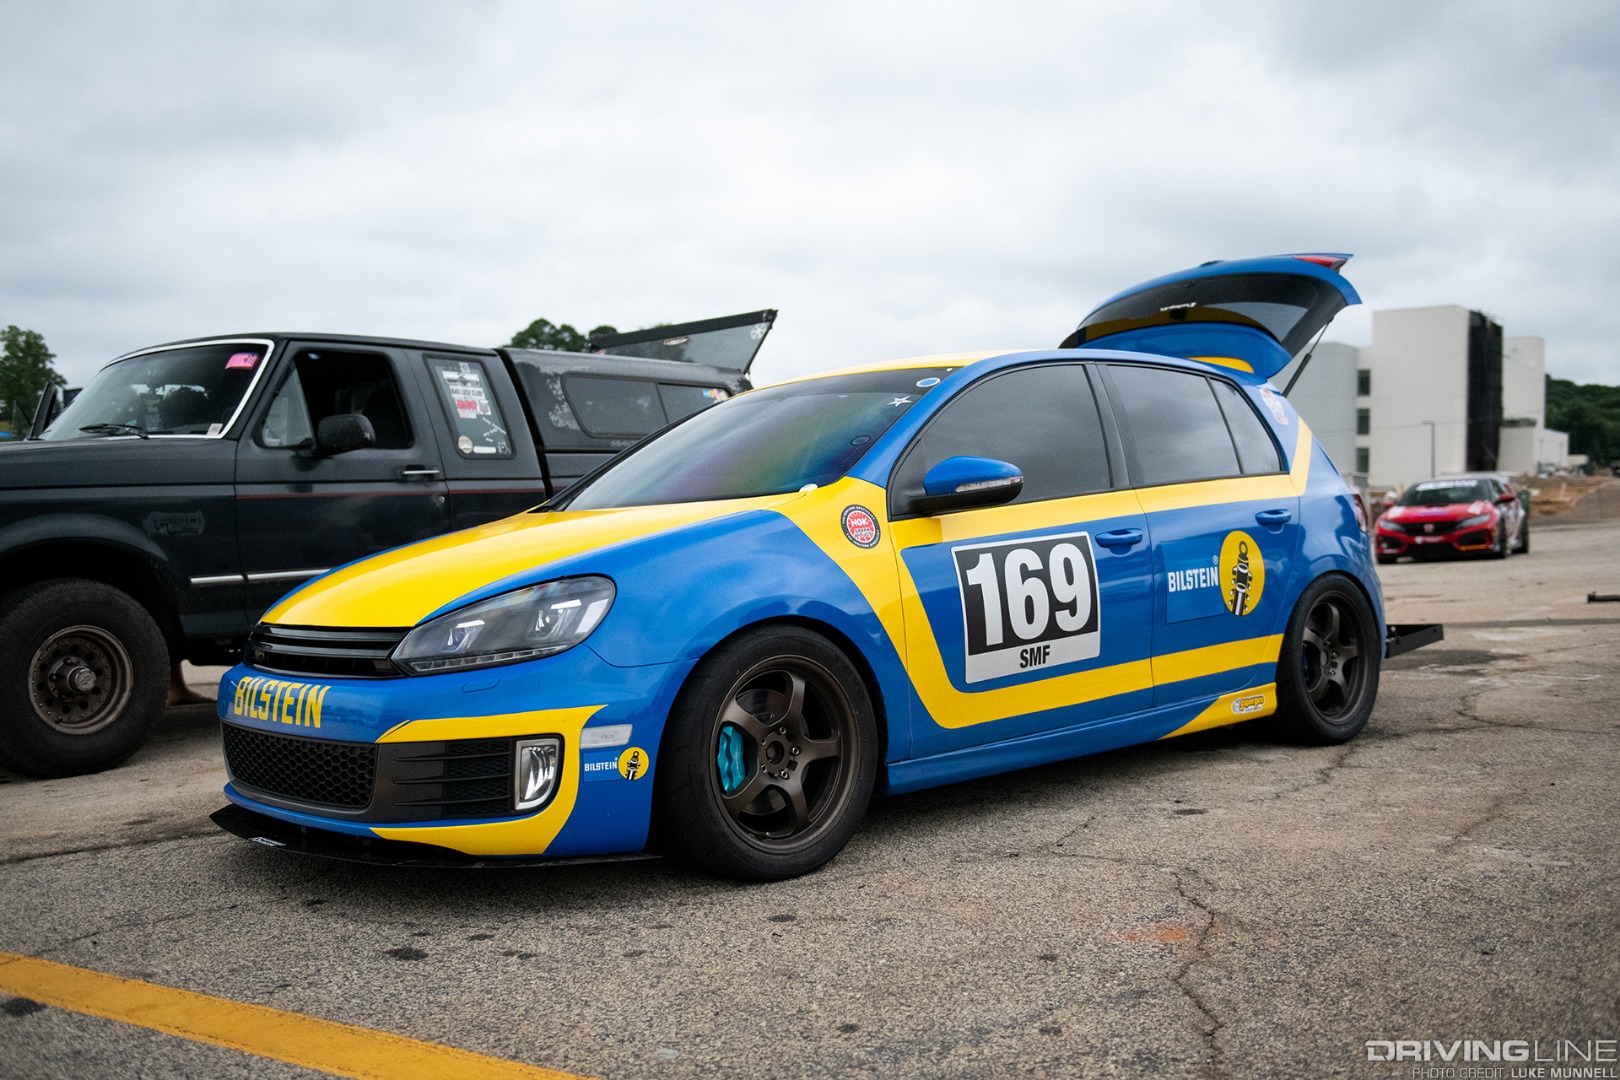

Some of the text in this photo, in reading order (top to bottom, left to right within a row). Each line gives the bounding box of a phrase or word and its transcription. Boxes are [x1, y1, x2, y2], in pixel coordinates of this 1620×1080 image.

[850, 517, 869, 527] NGK
[1167, 565, 1219, 593] BILSTEIN
[966, 543, 1092, 646] 169
[1019, 645, 1051, 669] SMF
[233, 676, 331, 729] BILSTEIN
[584, 760, 618, 772] BILSTEIN
